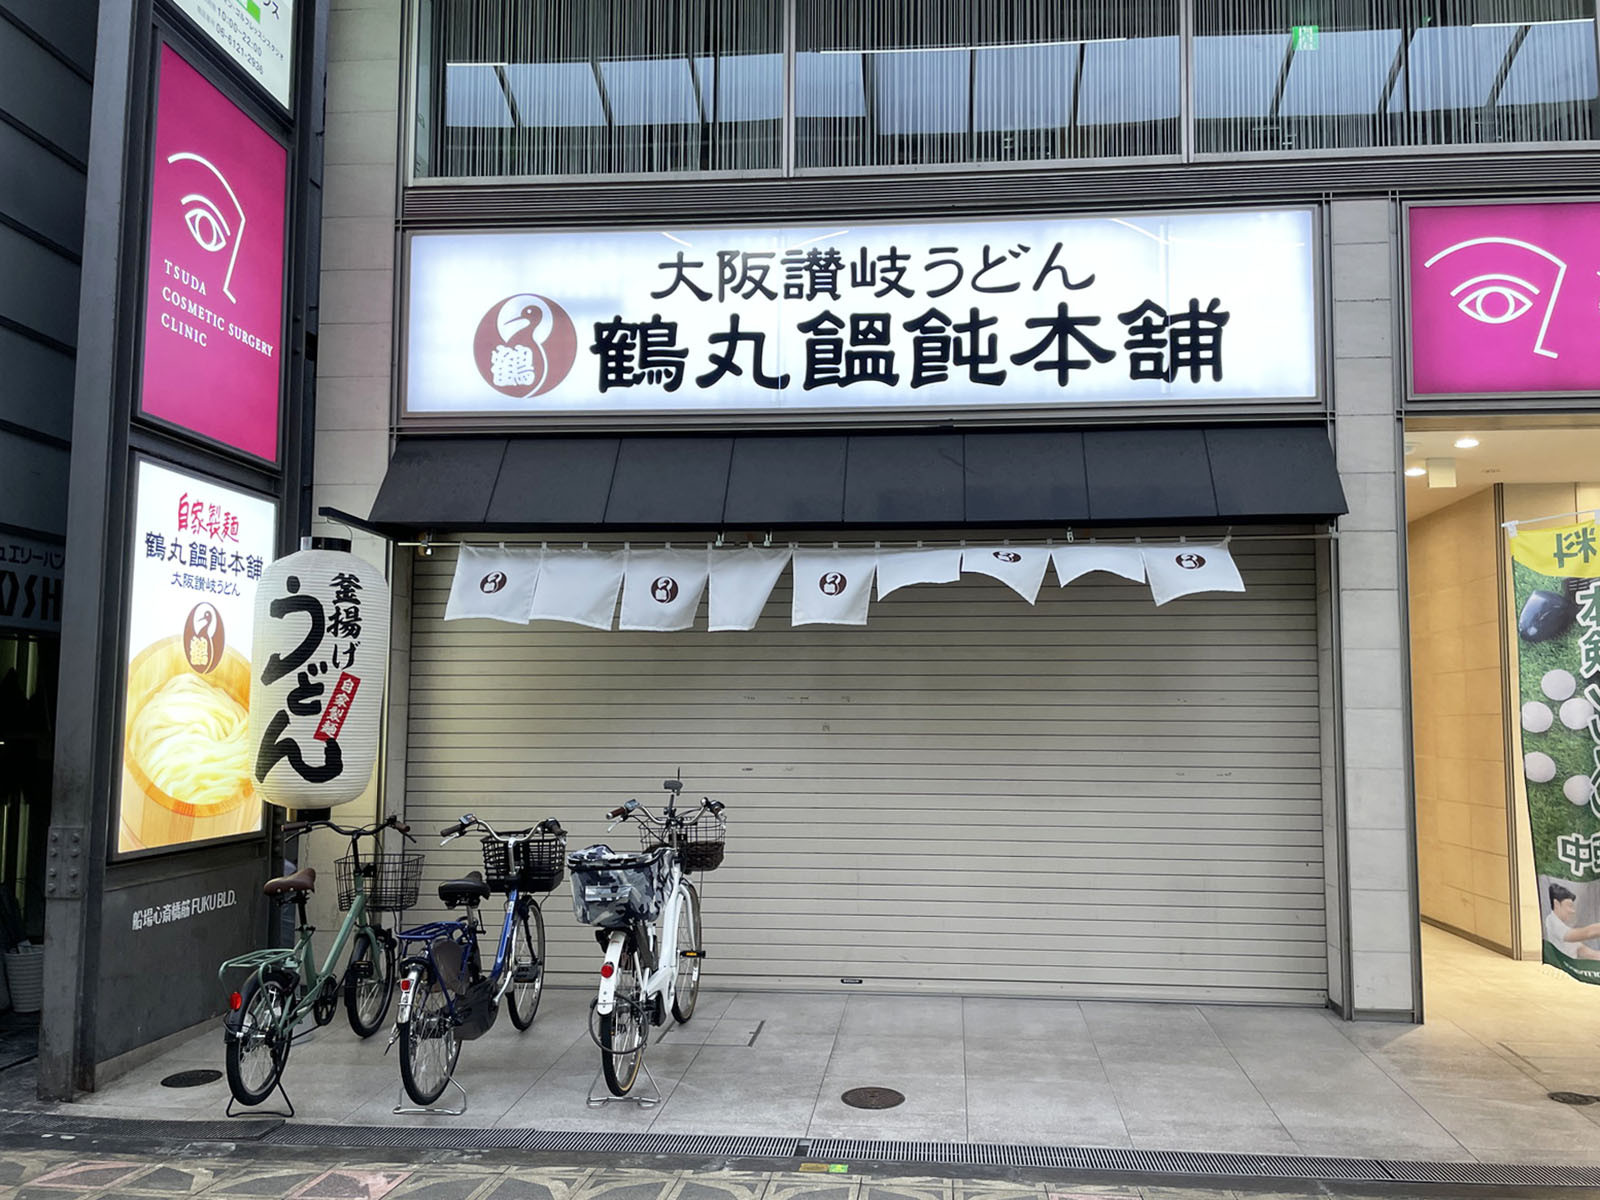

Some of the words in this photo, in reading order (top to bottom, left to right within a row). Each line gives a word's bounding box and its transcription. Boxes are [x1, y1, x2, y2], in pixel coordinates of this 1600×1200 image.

[164, 258, 207, 296] TSUDA
[651, 242, 1095, 303] 大阪讃岐うどん
[161, 312, 208, 348] CLINIC
[162, 286, 225, 332] COSMETIC
[228, 322, 274, 357] SURGERY
[589, 297, 1231, 394] 鶴丸饂飩本舗
[177, 492, 239, 543] 自家製麺
[145, 530, 264, 582] 鶴丸饂飩本舗
[170, 570, 241, 597] 大阪讃岐うどん
[326, 572, 364, 670] 釜揚げ
[255, 575, 343, 784] うどん
[191, 893, 217, 916] FUKU
[216, 889, 237, 909] BLD.
